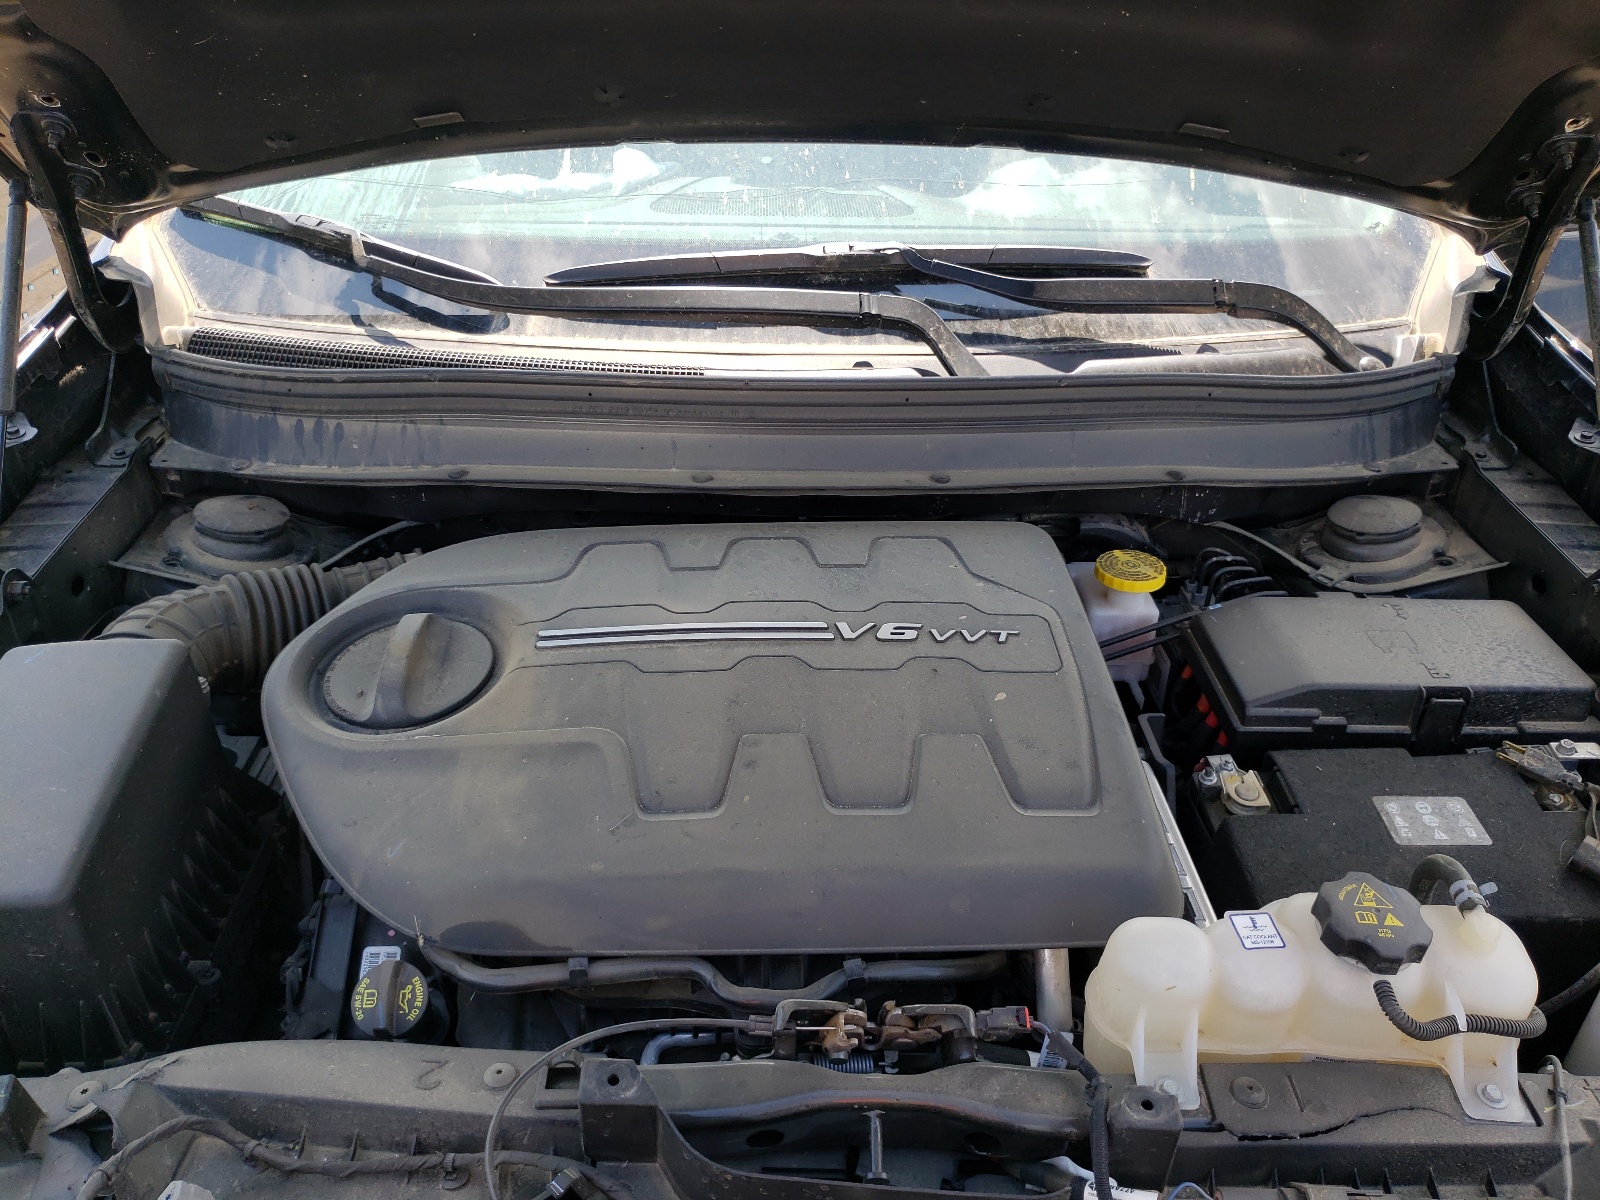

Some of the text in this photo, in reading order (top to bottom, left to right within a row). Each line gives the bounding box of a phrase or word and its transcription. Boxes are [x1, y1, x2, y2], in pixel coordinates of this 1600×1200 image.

[835, 620, 1020, 646] V6 VVT
[357, 977, 371, 994] SAE
[406, 976, 424, 1022] ENGINE OIL
